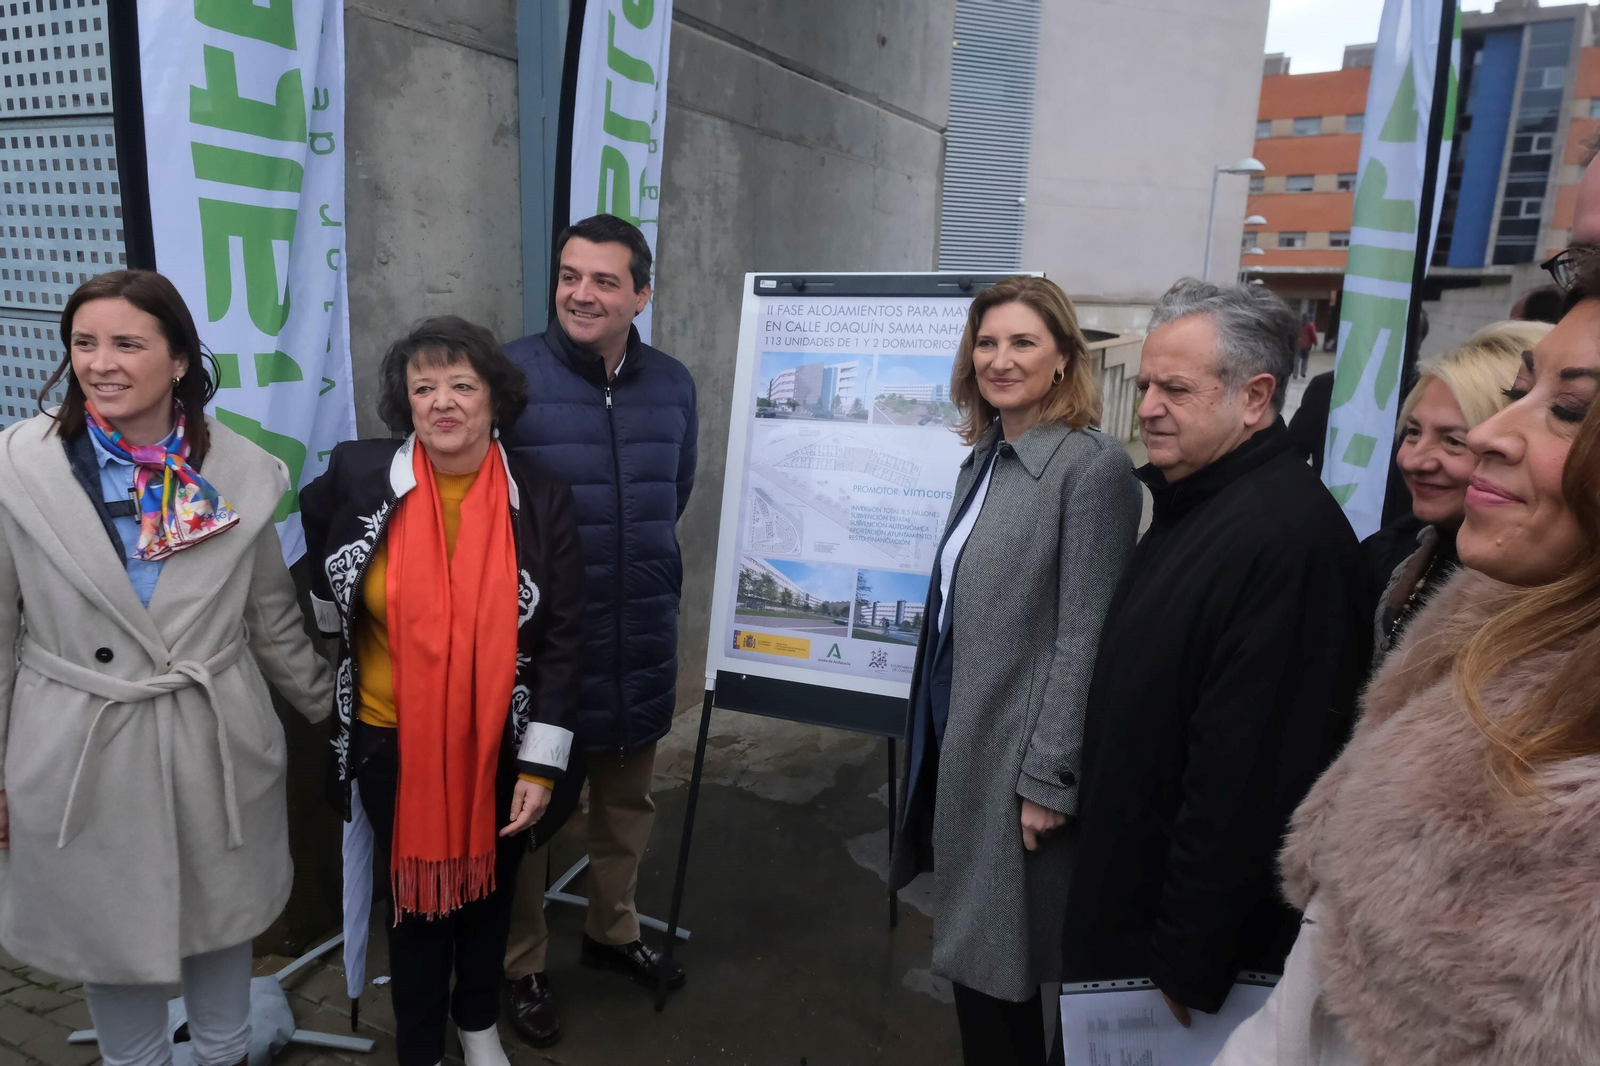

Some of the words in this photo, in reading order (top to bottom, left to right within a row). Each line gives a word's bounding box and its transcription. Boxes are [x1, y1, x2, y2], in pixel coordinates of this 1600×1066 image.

[767, 304, 774, 316] II
[777, 304, 804, 316] FASE
[807, 304, 903, 317] ALOJAMIENTOS
[907, 305, 938, 318] PARA
[765, 320, 782, 332] EN
[785, 321, 821, 333] CALLE
[824, 319, 884, 334] JOAQUÍN
[888, 322, 924, 334] SAMA
[765, 336, 782, 346] 113
[784, 336, 835, 347] UNIDADES
[837, 337, 851, 347] DE
[855, 338, 859, 347] 1
[863, 338, 870, 347] Y
[873, 338, 879, 348] 2
[882, 338, 958, 350] DORMITORIOS
[853, 484, 901, 496] PROMOTOR:
[883, 507, 900, 515] TOTAL
[911, 509, 941, 518] MILLONES
[889, 515, 911, 523] ESTATAL
[848, 534, 866, 542] RESTO
[887, 529, 932, 540] AYUNTAMIENTO
